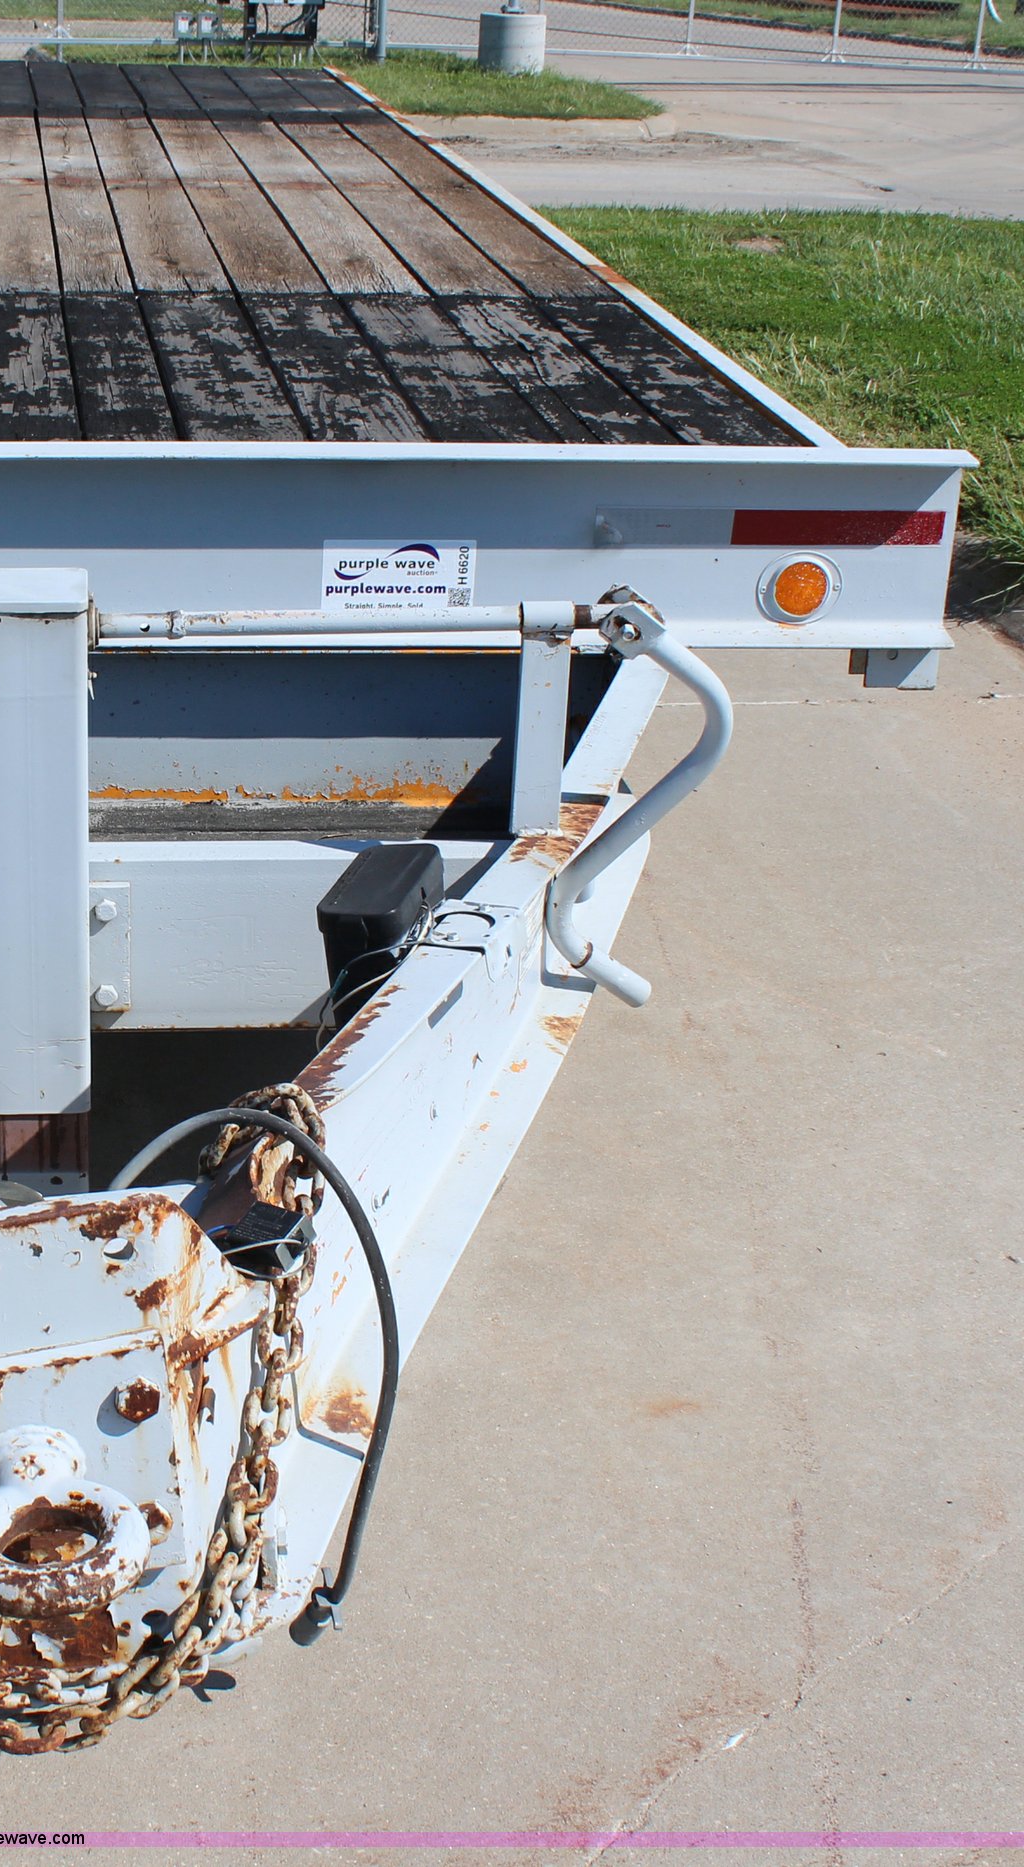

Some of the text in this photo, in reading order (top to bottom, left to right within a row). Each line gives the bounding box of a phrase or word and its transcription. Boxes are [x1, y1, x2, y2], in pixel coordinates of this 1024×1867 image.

[339, 558, 435, 571] purple wave
[457, 546, 470, 585] H 6620
[325, 582, 446, 597] purplewave.com
